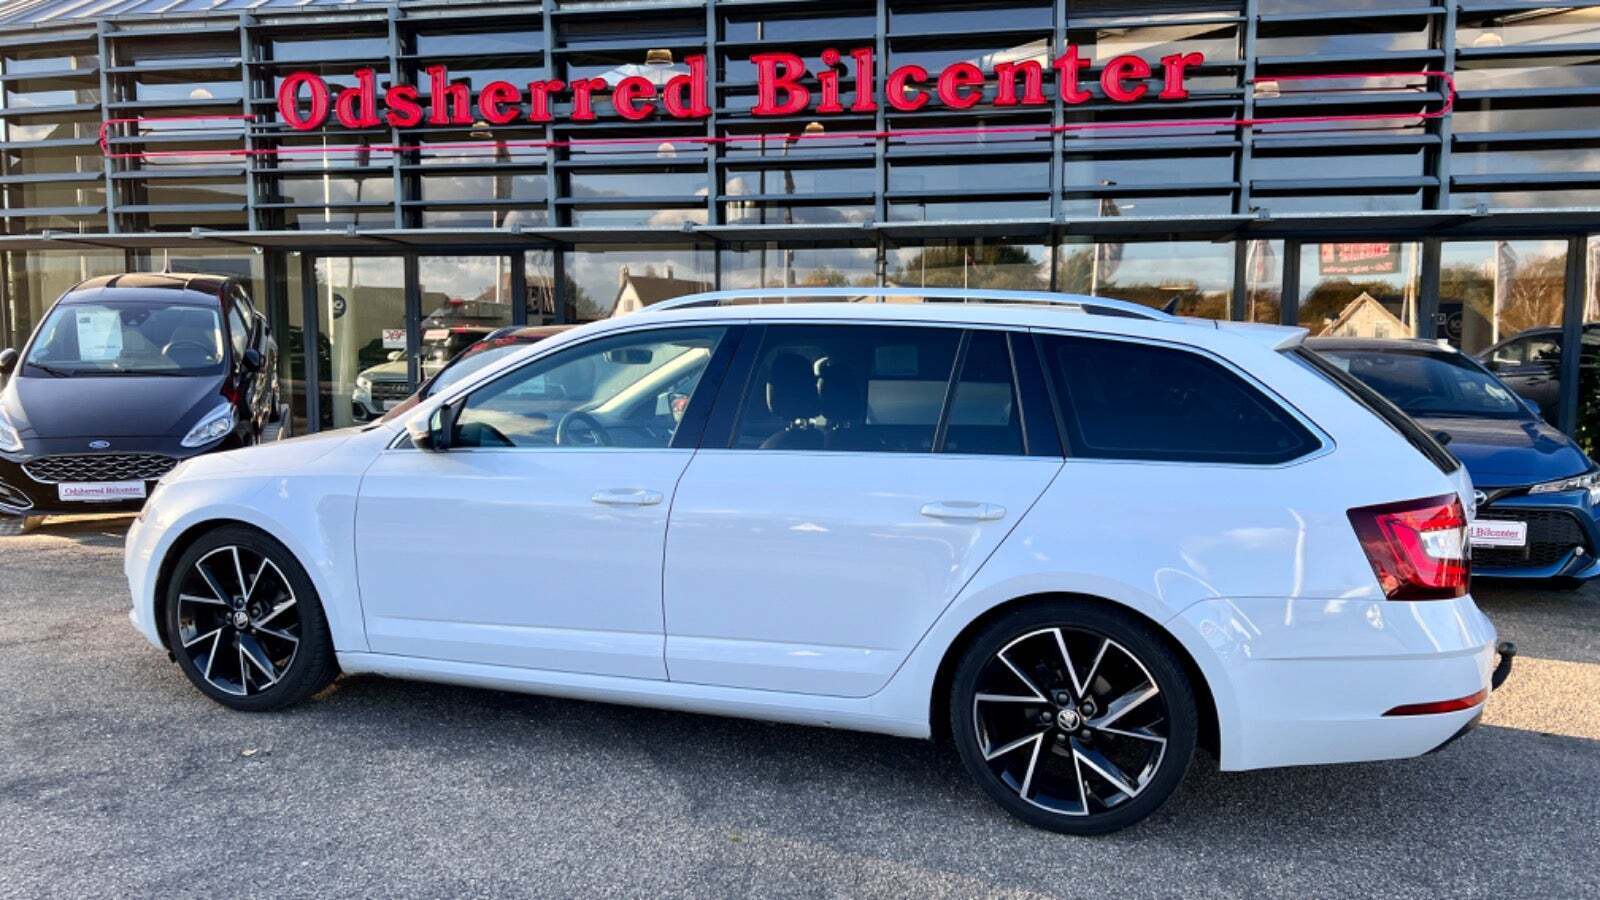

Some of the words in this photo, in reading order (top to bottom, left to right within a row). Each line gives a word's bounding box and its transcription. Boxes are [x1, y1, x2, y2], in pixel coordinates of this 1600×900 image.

[277, 54, 713, 132] Odsherred
[750, 44, 1206, 117] Bilcenter
[64, 487, 104, 496] Odsherred
[1476, 527, 1520, 538] Bilcenter
